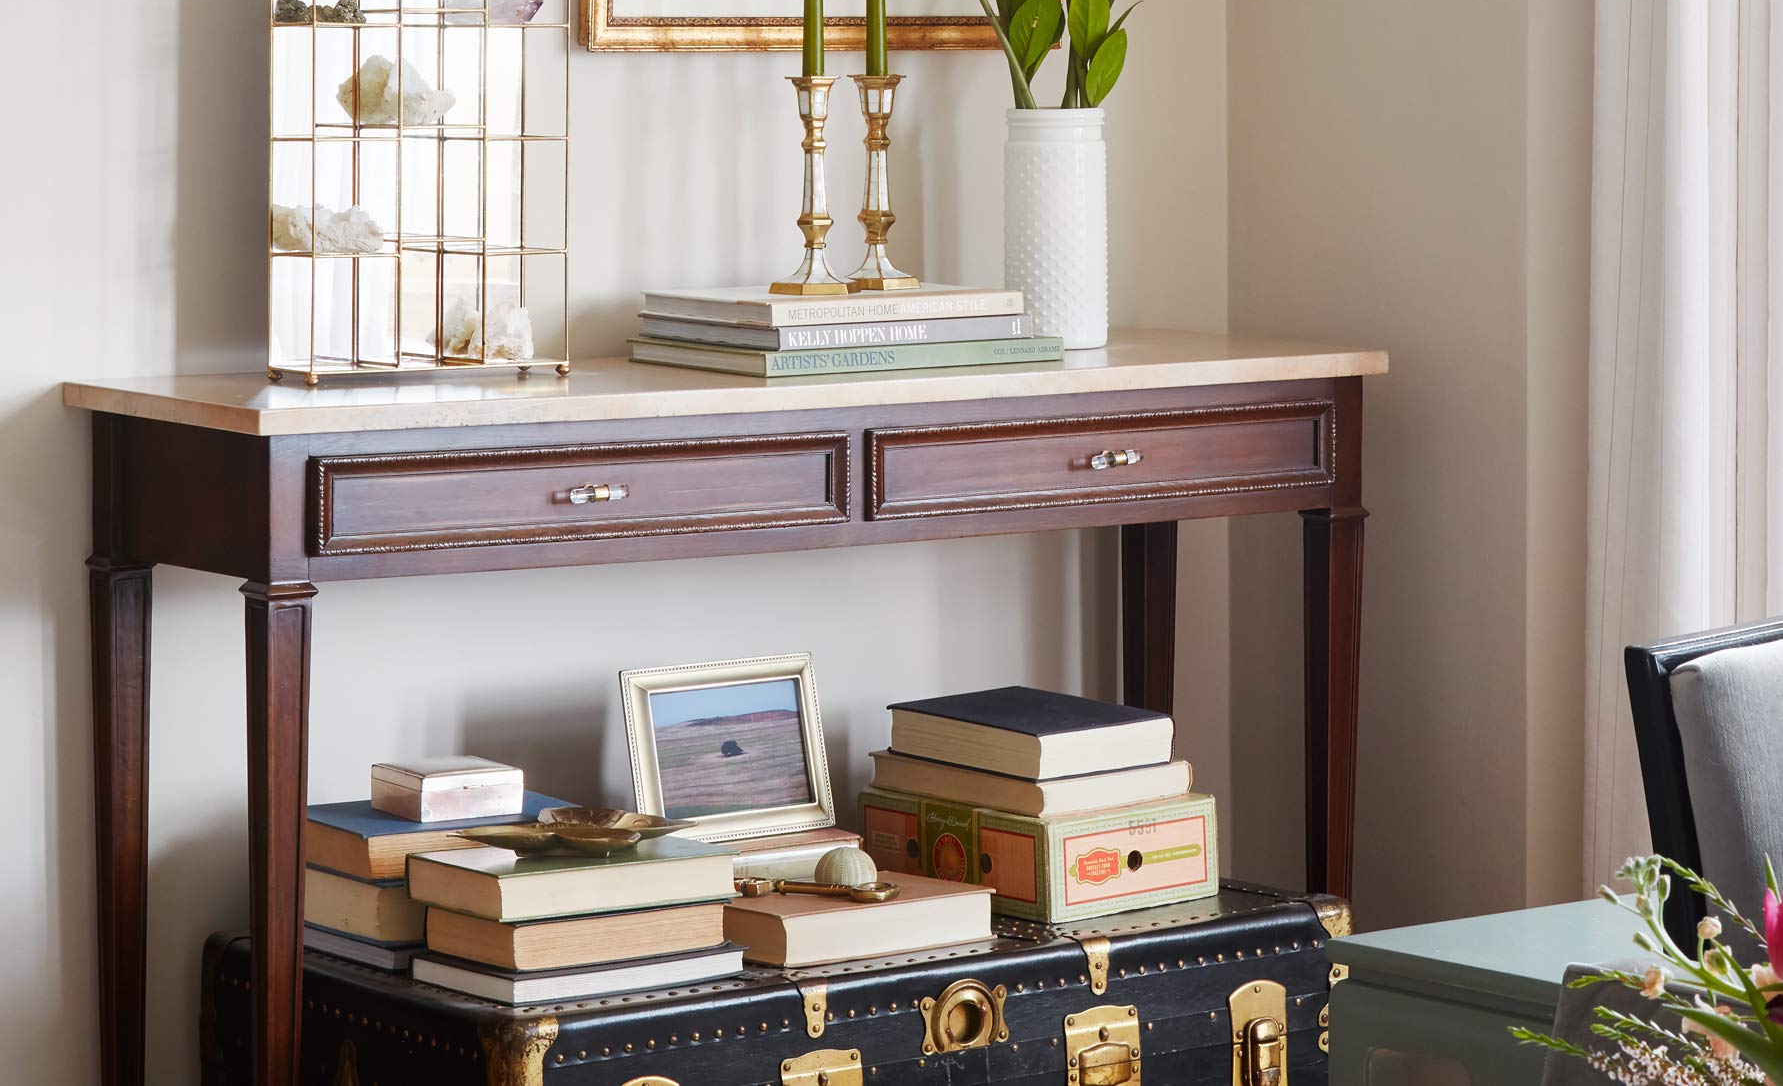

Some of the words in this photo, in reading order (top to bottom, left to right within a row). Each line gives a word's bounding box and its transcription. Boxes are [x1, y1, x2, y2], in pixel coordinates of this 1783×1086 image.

[788, 305, 865, 320] METROPOLITAN
[868, 303, 898, 315] HOME
[901, 300, 953, 314] AMERICAN
[956, 298, 985, 311] STYLE
[788, 329, 832, 347] KELLY
[835, 326, 887, 345] HOPPEN
[890, 324, 928, 342] HOME
[831, 350, 896, 367] GARDENS
